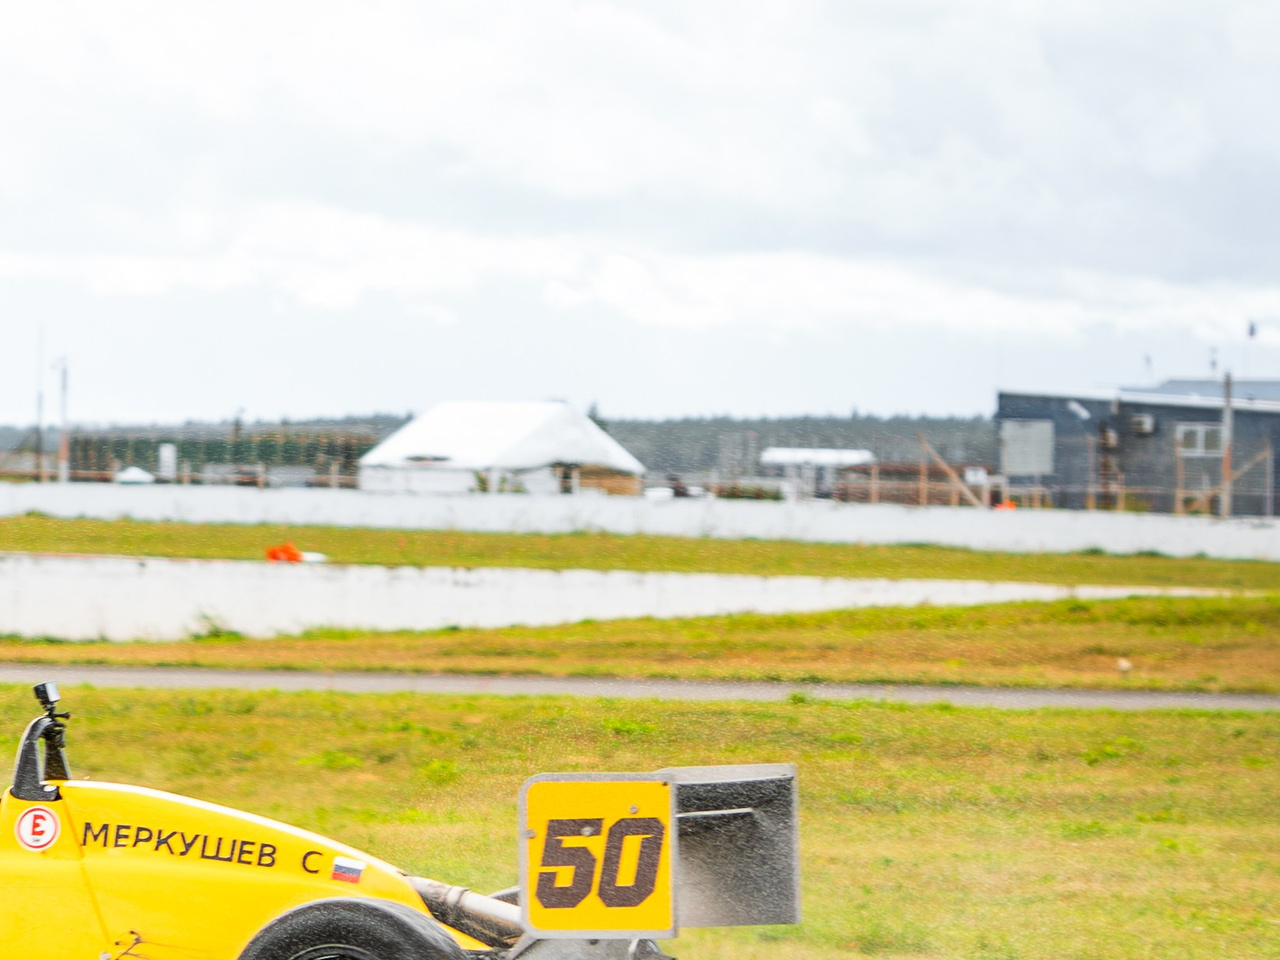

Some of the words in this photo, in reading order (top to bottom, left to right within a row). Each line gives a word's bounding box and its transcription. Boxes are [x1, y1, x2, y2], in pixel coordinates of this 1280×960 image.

[31, 813, 47, 836] E
[81, 821, 277, 868] МЕРКУШЕВ
[301, 850, 324, 874] С
[535, 817, 666, 909] 50
